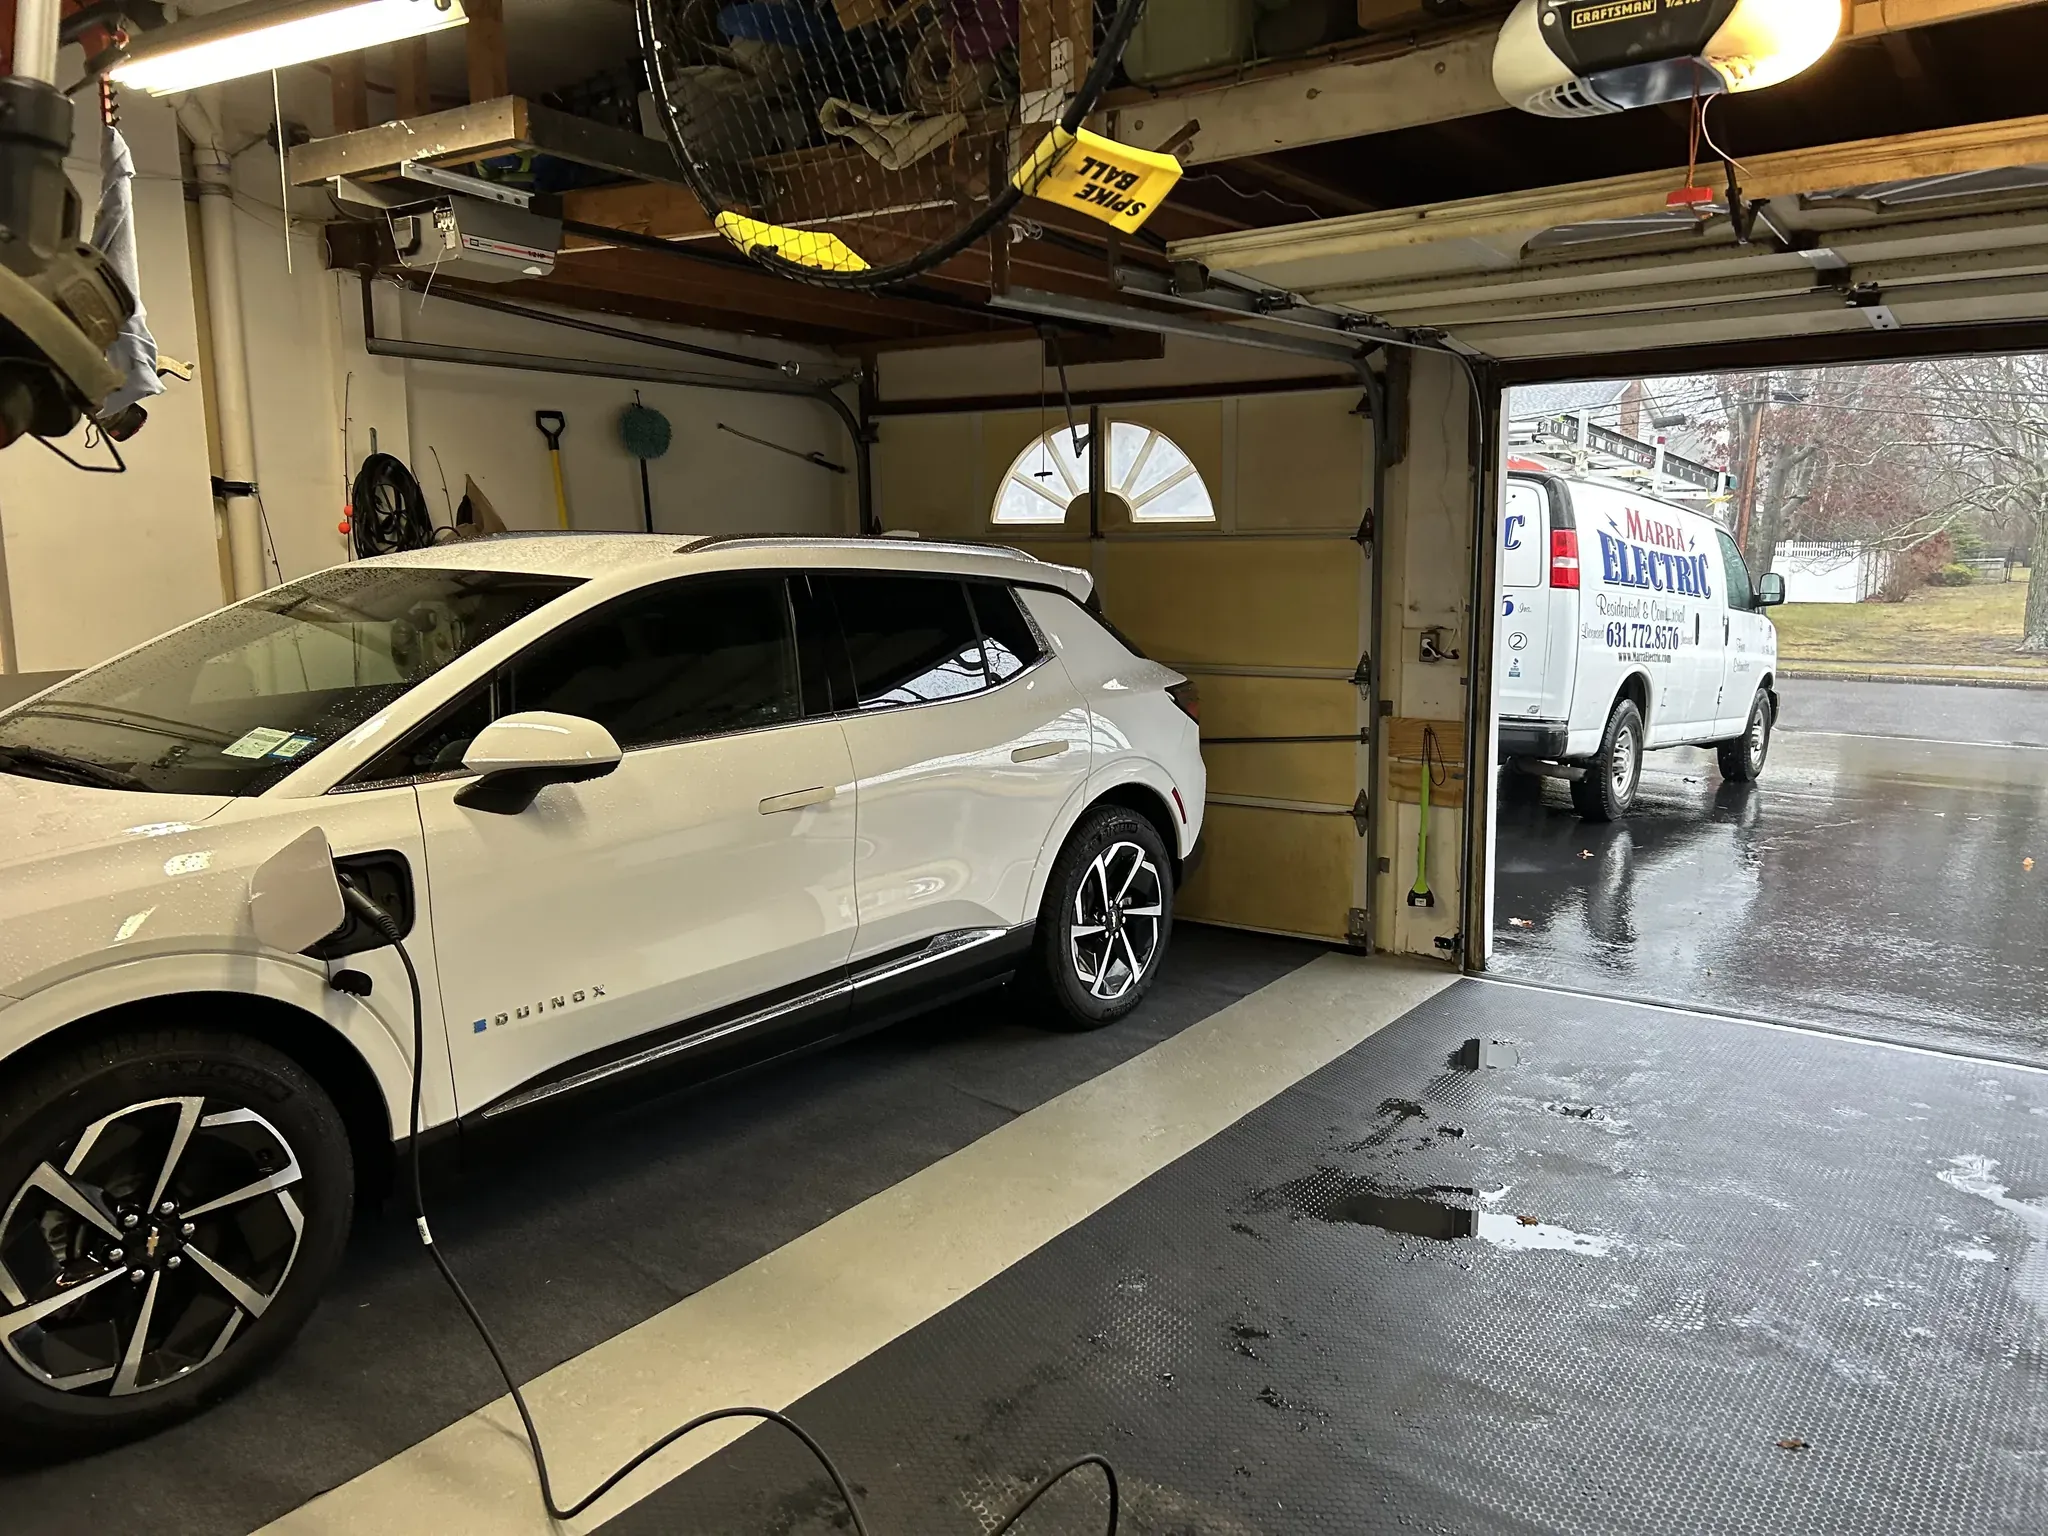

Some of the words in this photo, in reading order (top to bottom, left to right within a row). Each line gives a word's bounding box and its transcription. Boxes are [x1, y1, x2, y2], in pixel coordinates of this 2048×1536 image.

[1576, 2, 1651, 24] CRAFTSMAN
[1075, 156, 1140, 191] BALL
[1073, 182, 1147, 217] SPIKE
[1625, 507, 1685, 552] MARRA
[1596, 529, 1711, 599] ELECTRIC
[1596, 593, 1641, 619] Residential
[1643, 601, 1649, 619] &
[1512, 634, 1523, 649] 2
[1606, 621, 1679, 650] 631.772.8576
